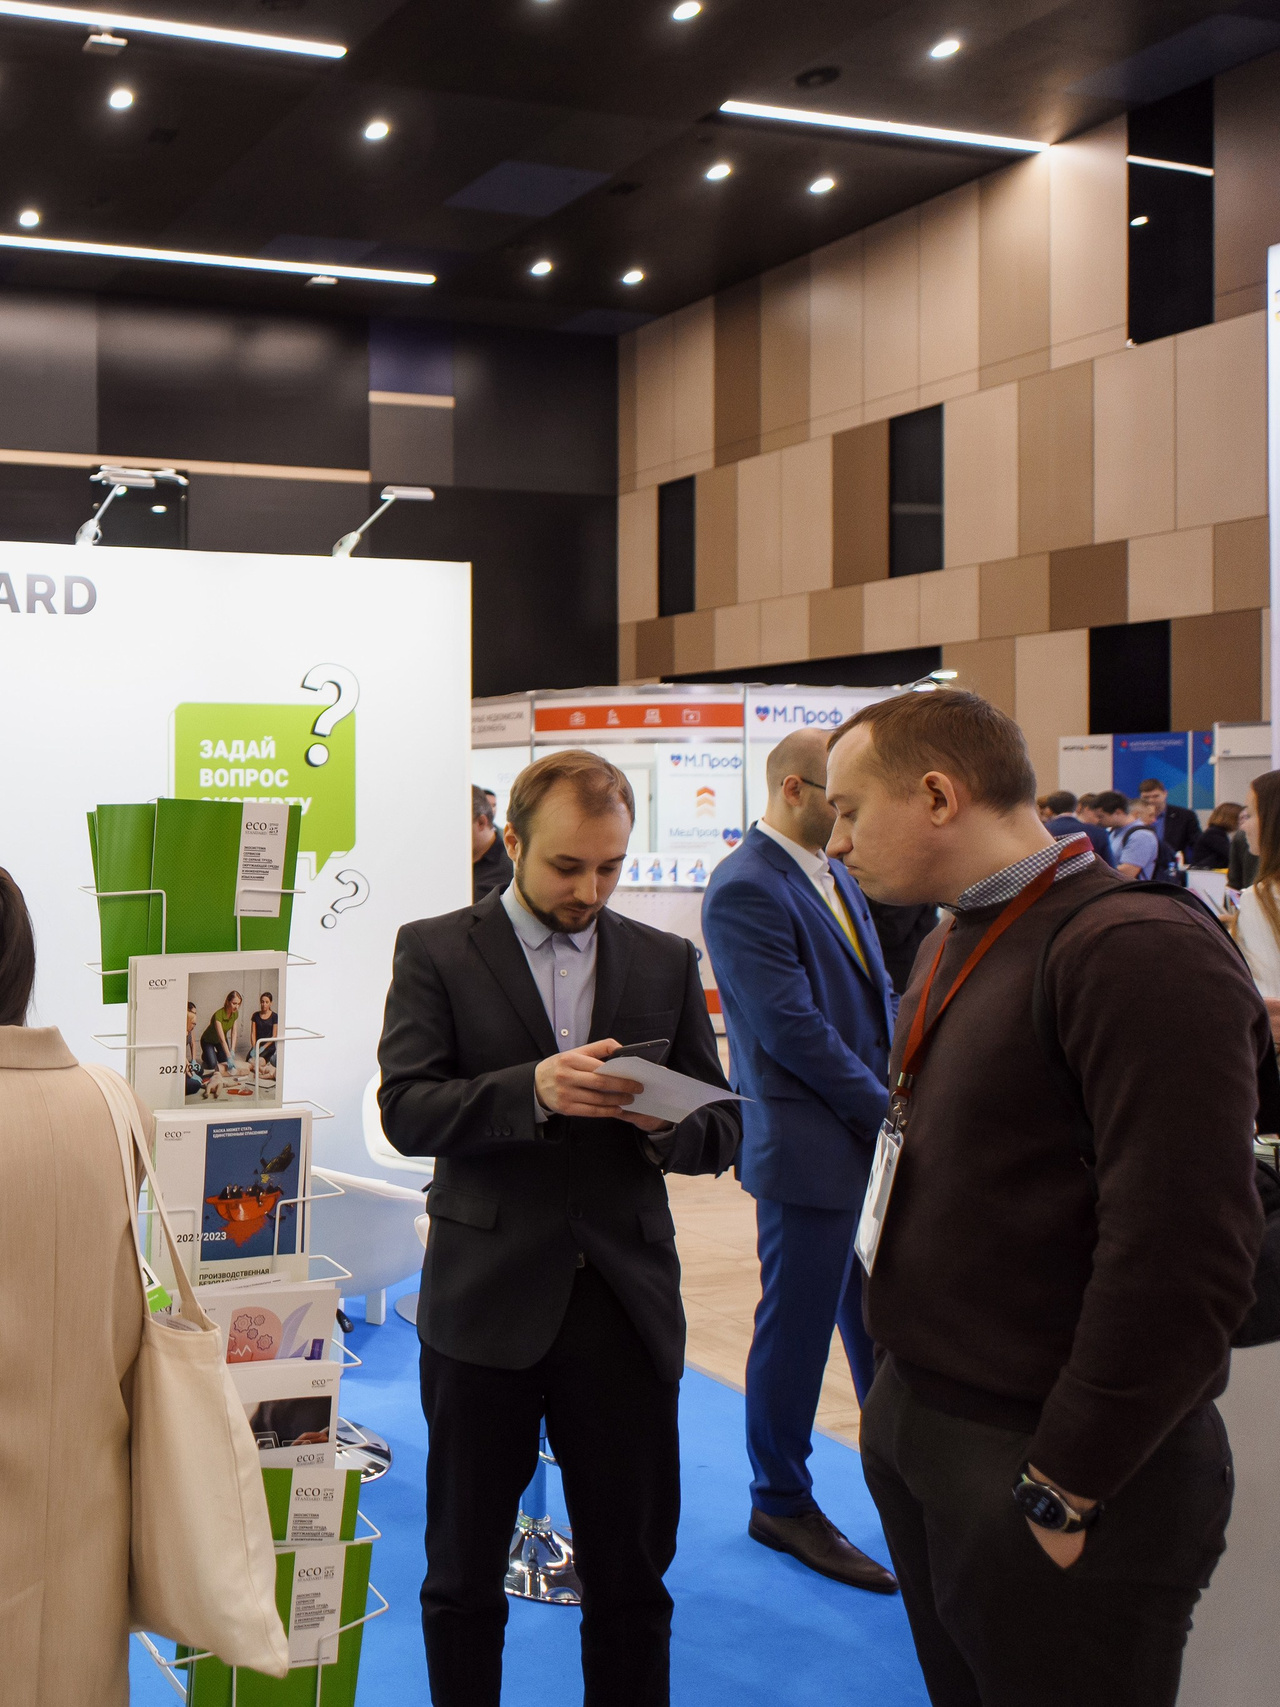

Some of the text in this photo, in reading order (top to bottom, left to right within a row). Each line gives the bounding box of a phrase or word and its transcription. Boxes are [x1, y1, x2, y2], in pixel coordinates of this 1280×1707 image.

[773, 704, 843, 725] М.Проф
[199, 735, 276, 762] ЗАДАЙ
[684, 753, 742, 769] М.Проф
[199, 768, 289, 787] ВОПРОС
[245, 821, 267, 831] eco
[164, 1130, 182, 1139] eco
[199, 1268, 270, 1280] ПРОИЗВОДСТВЕННАЯ
[296, 1453, 315, 1463] eco
[295, 1487, 320, 1497] eco
[298, 1566, 322, 1578] eco
